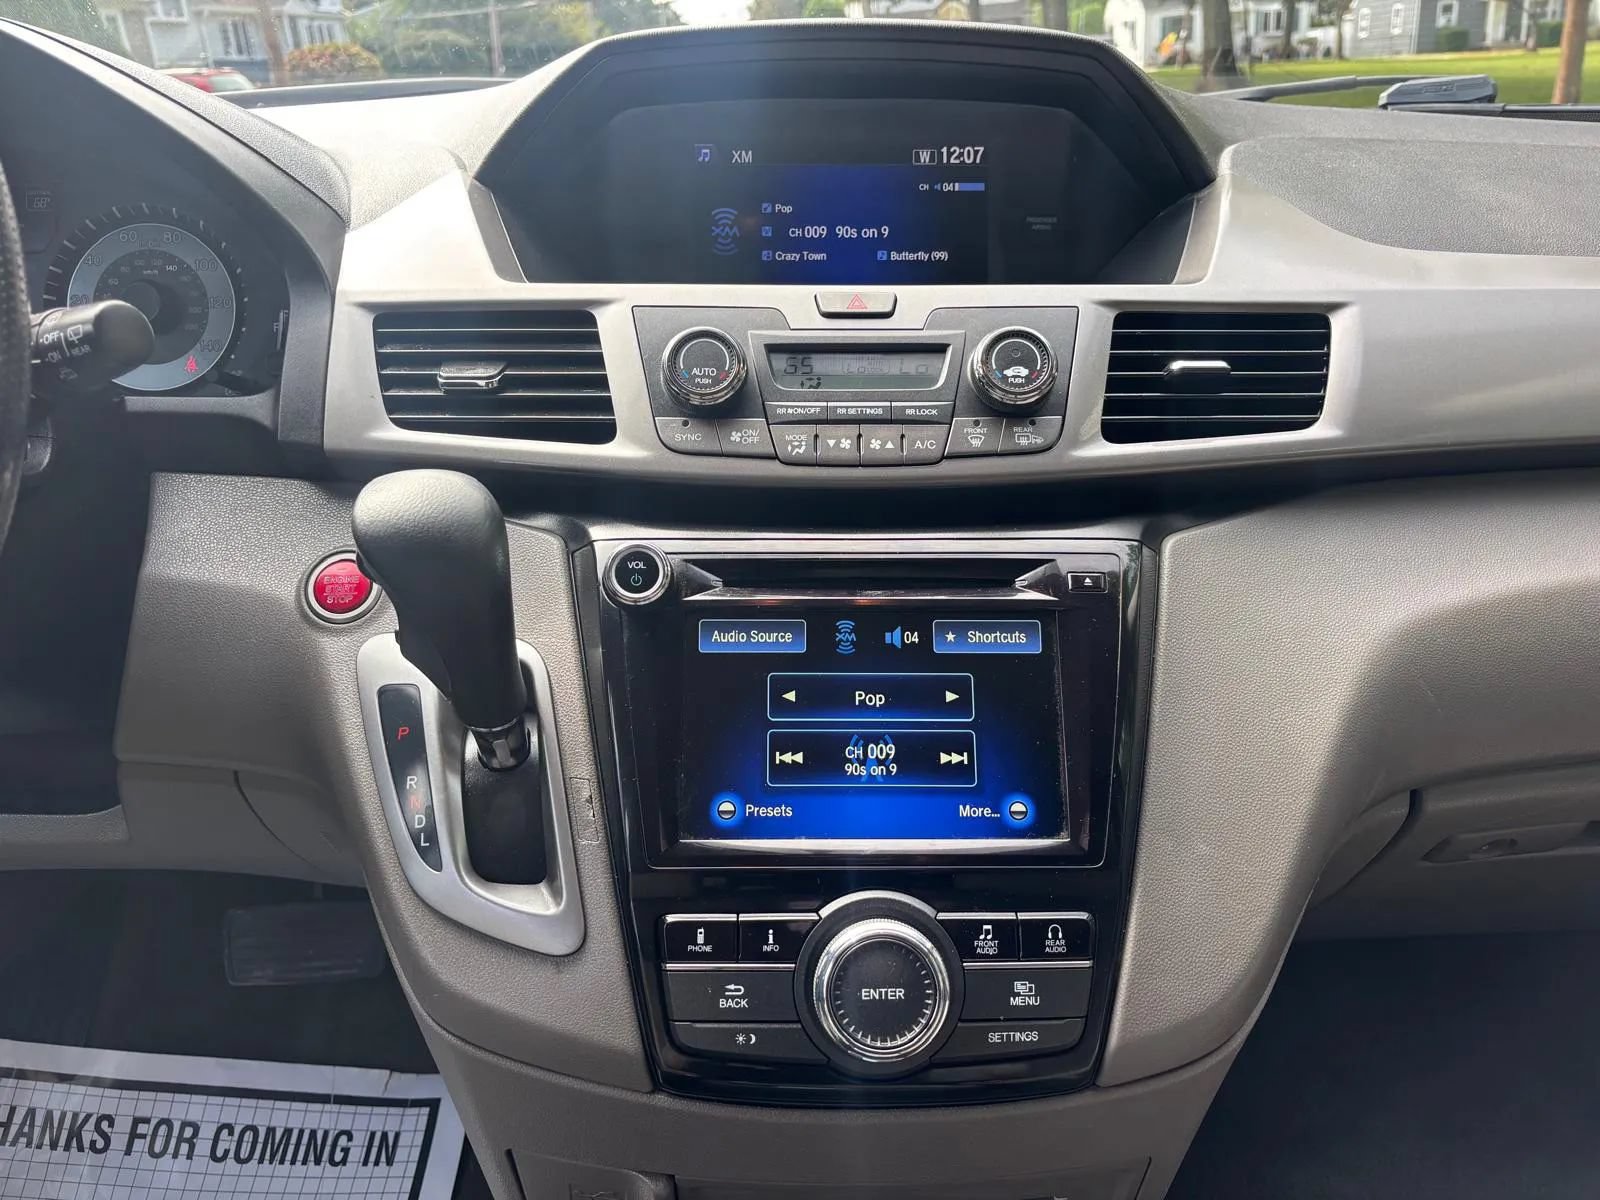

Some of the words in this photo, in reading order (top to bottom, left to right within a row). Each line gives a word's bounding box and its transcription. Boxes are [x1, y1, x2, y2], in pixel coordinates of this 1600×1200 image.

[732, 150, 753, 164] XM
[941, 147, 984, 164] 12:07
[943, 182, 953, 191] 04
[775, 204, 793, 214] Pop
[119, 231, 137, 241] 60
[163, 232, 181, 243] 80
[789, 228, 802, 237] CH
[804, 226, 827, 238] 009
[836, 226, 857, 239] 90s
[861, 228, 878, 238] on
[881, 226, 889, 238] 9
[775, 252, 800, 262] Crazy
[802, 252, 827, 261] Town
[890, 252, 929, 262] Butterfly
[931, 251, 948, 262] (99)
[195, 260, 217, 271] 100
[210, 297, 232, 308] 120
[43, 331, 59, 344] OFF
[691, 367, 717, 376] AUTO
[794, 407, 821, 415] ON/OFF
[675, 433, 702, 441] SYNC
[742, 429, 760, 437] ON/
[915, 440, 936, 449] A/C
[628, 561, 647, 569] VOL
[324, 575, 360, 584] ENGINE
[325, 584, 357, 593] START
[327, 596, 353, 604] STOP
[711, 630, 747, 644] Audio
[750, 630, 793, 644] Source
[903, 631, 919, 644] 04
[967, 630, 1027, 644] Shortcuts
[855, 691, 885, 707] Pop
[397, 727, 409, 739] P
[846, 747, 863, 759] CH
[867, 744, 896, 760] 009
[845, 764, 866, 776] 90s
[870, 765, 887, 776] on
[889, 764, 897, 776] 9
[407, 776, 417, 789] R
[746, 805, 793, 818] Presets
[959, 805, 1000, 818] More...
[415, 815, 426, 828] D
[421, 833, 430, 846] L
[861, 988, 905, 1000] ENTER
[719, 998, 748, 1008] BACK
[1010, 996, 1040, 1006] MENU
[988, 1031, 1039, 1042] SETTINGS
[124, 1116, 200, 1161] FOR
[210, 1123, 354, 1167] COMING
[362, 1130, 400, 1167] IN
